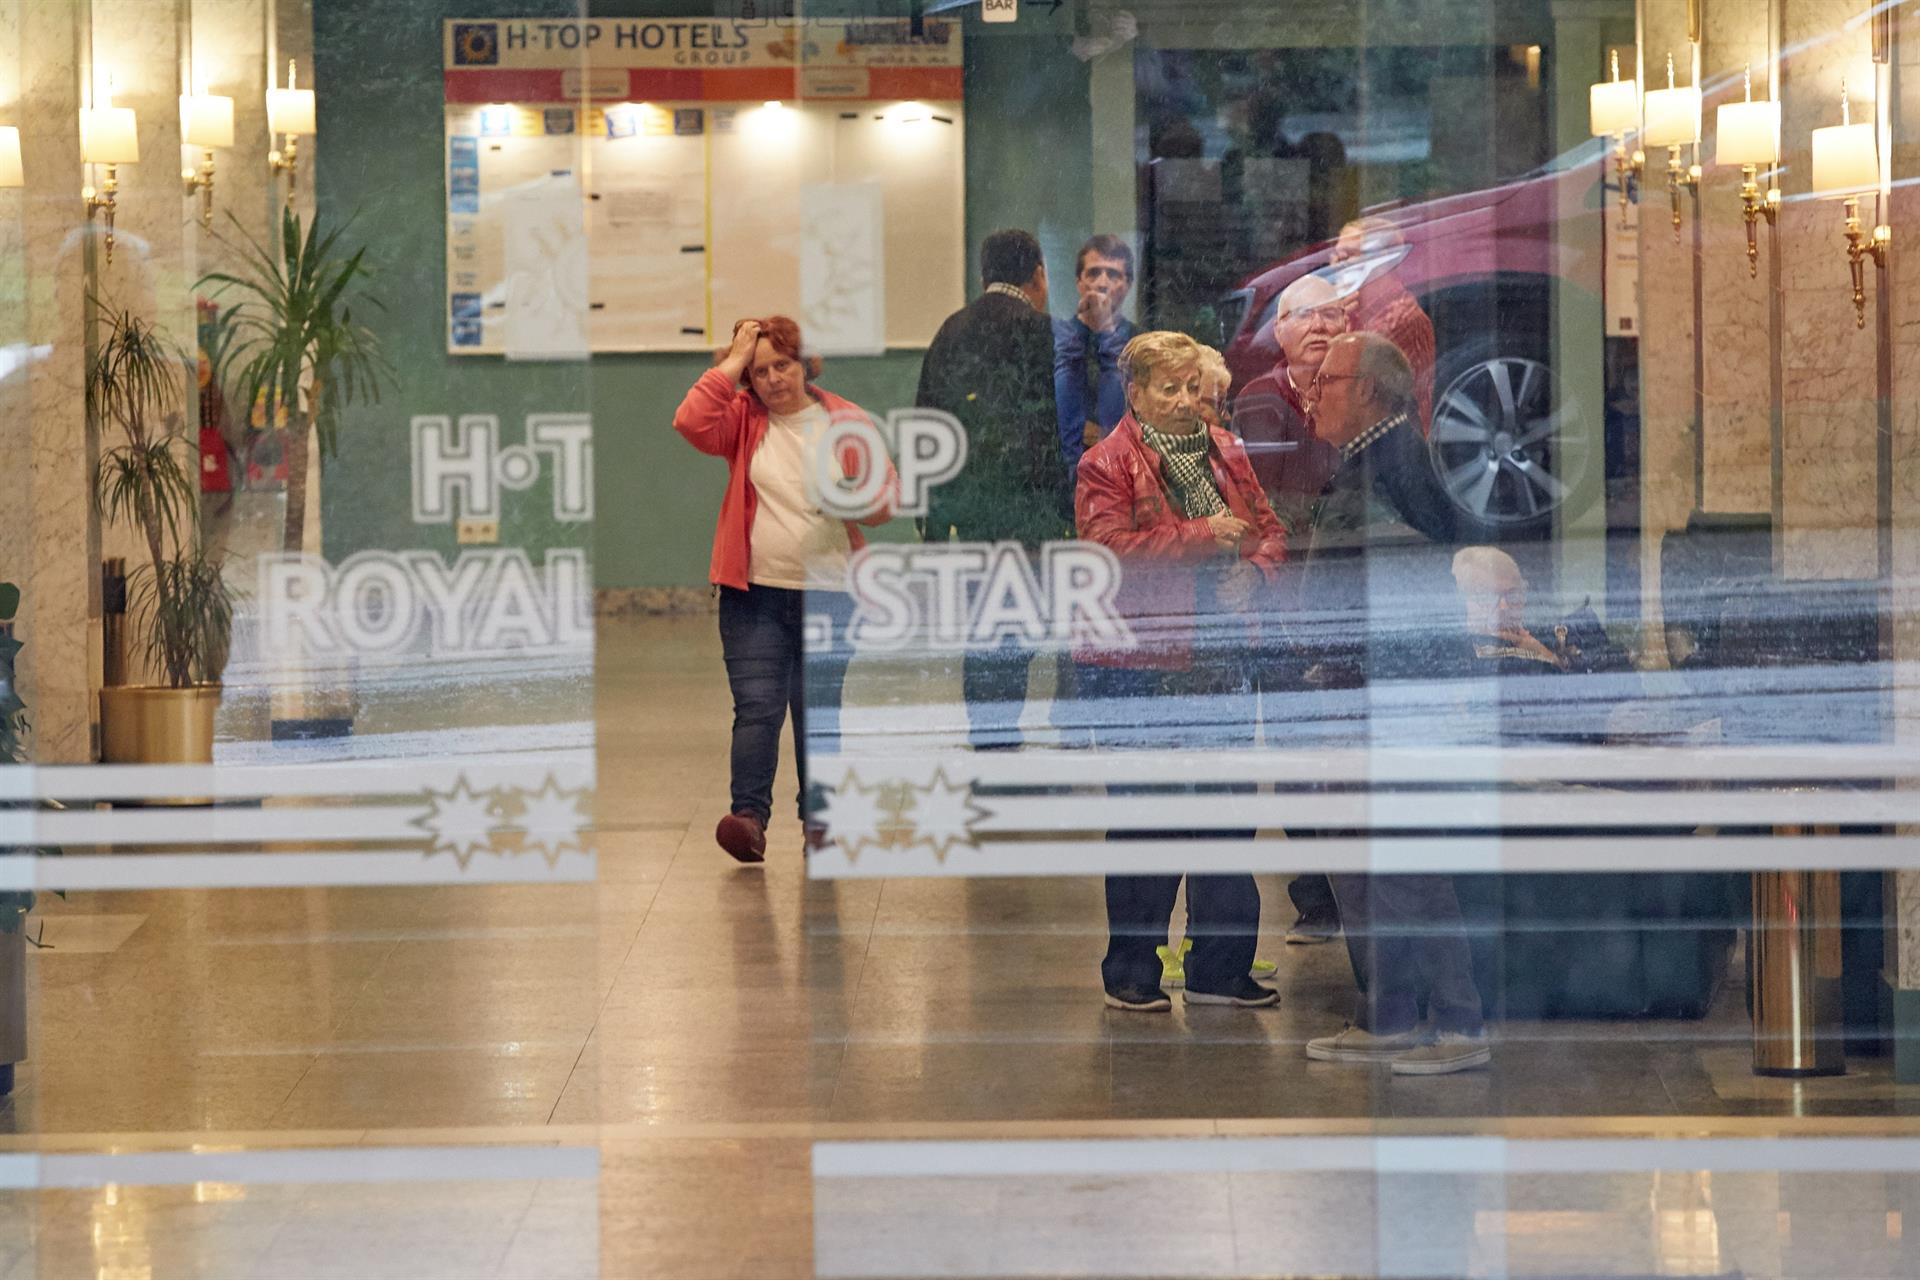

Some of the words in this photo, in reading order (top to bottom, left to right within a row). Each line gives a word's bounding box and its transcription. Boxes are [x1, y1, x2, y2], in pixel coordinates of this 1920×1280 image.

[985, 0, 1013, 11] BAR
[615, 24, 749, 49] HOTELS
[674, 51, 750, 65] GROUP
[257, 548, 595, 660] ROYAL
